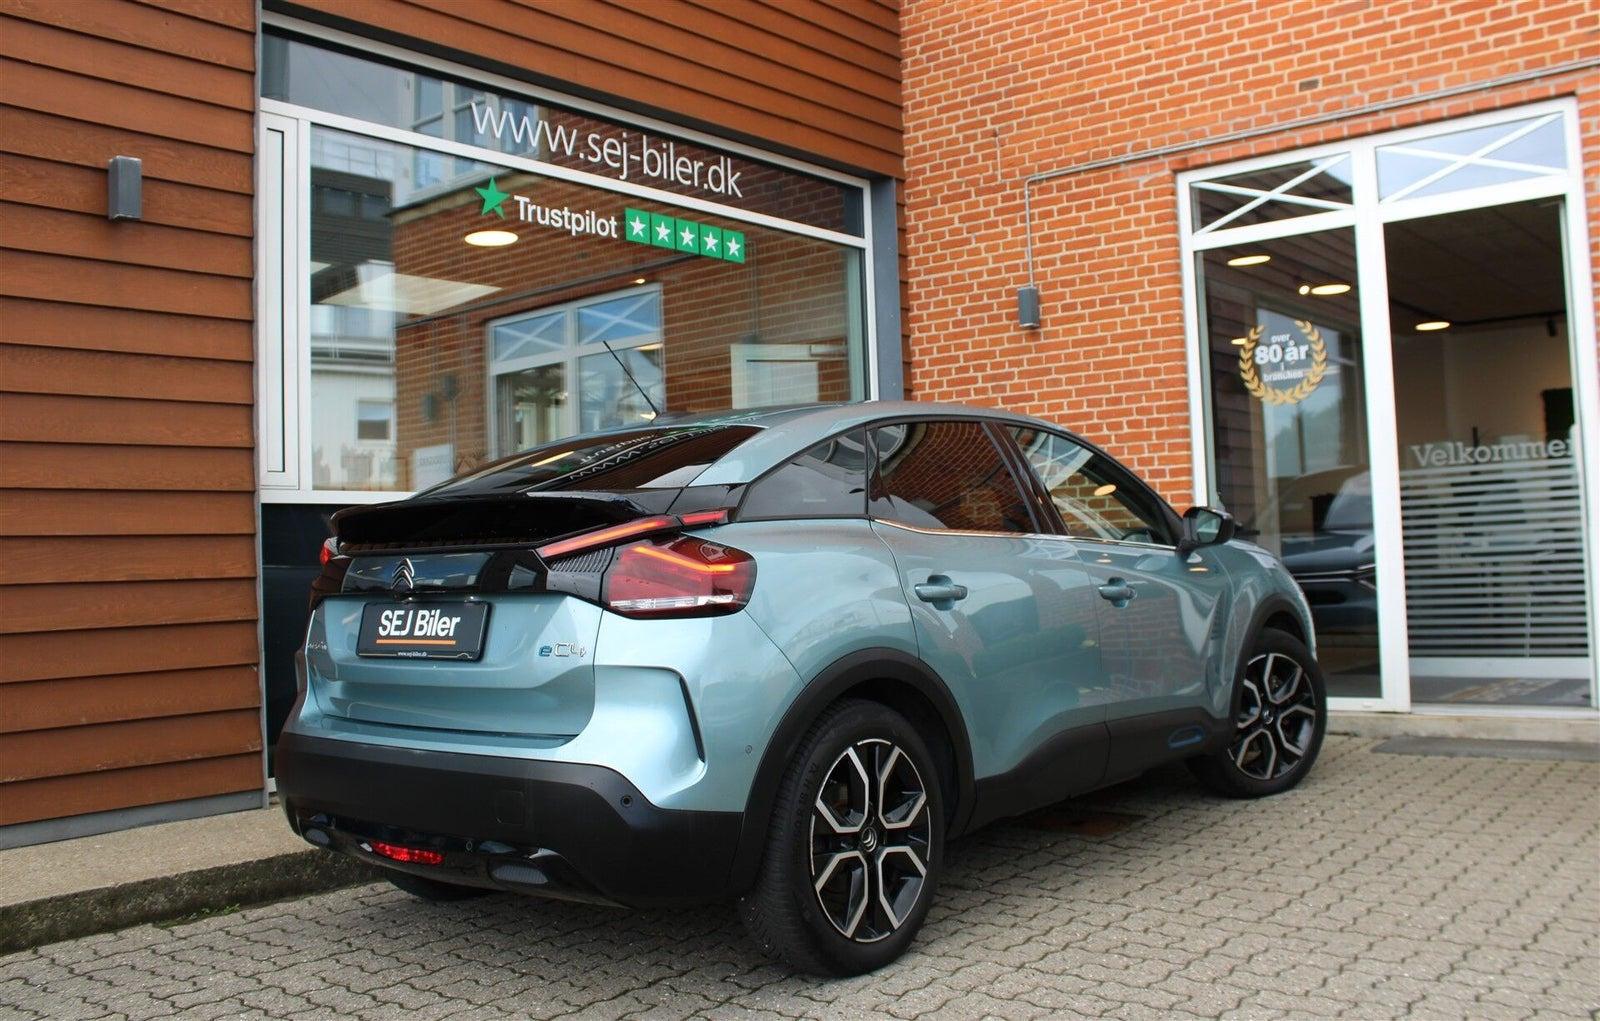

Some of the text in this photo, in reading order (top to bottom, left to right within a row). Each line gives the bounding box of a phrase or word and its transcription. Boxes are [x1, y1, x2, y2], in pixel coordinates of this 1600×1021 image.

[471, 102, 743, 197] www.sej-biler.dk
[513, 195, 618, 238] Trustpilot
[1255, 340, 1309, 365] 80 år
[1271, 333, 1291, 343] over
[379, 608, 461, 637] SEJ Biler
